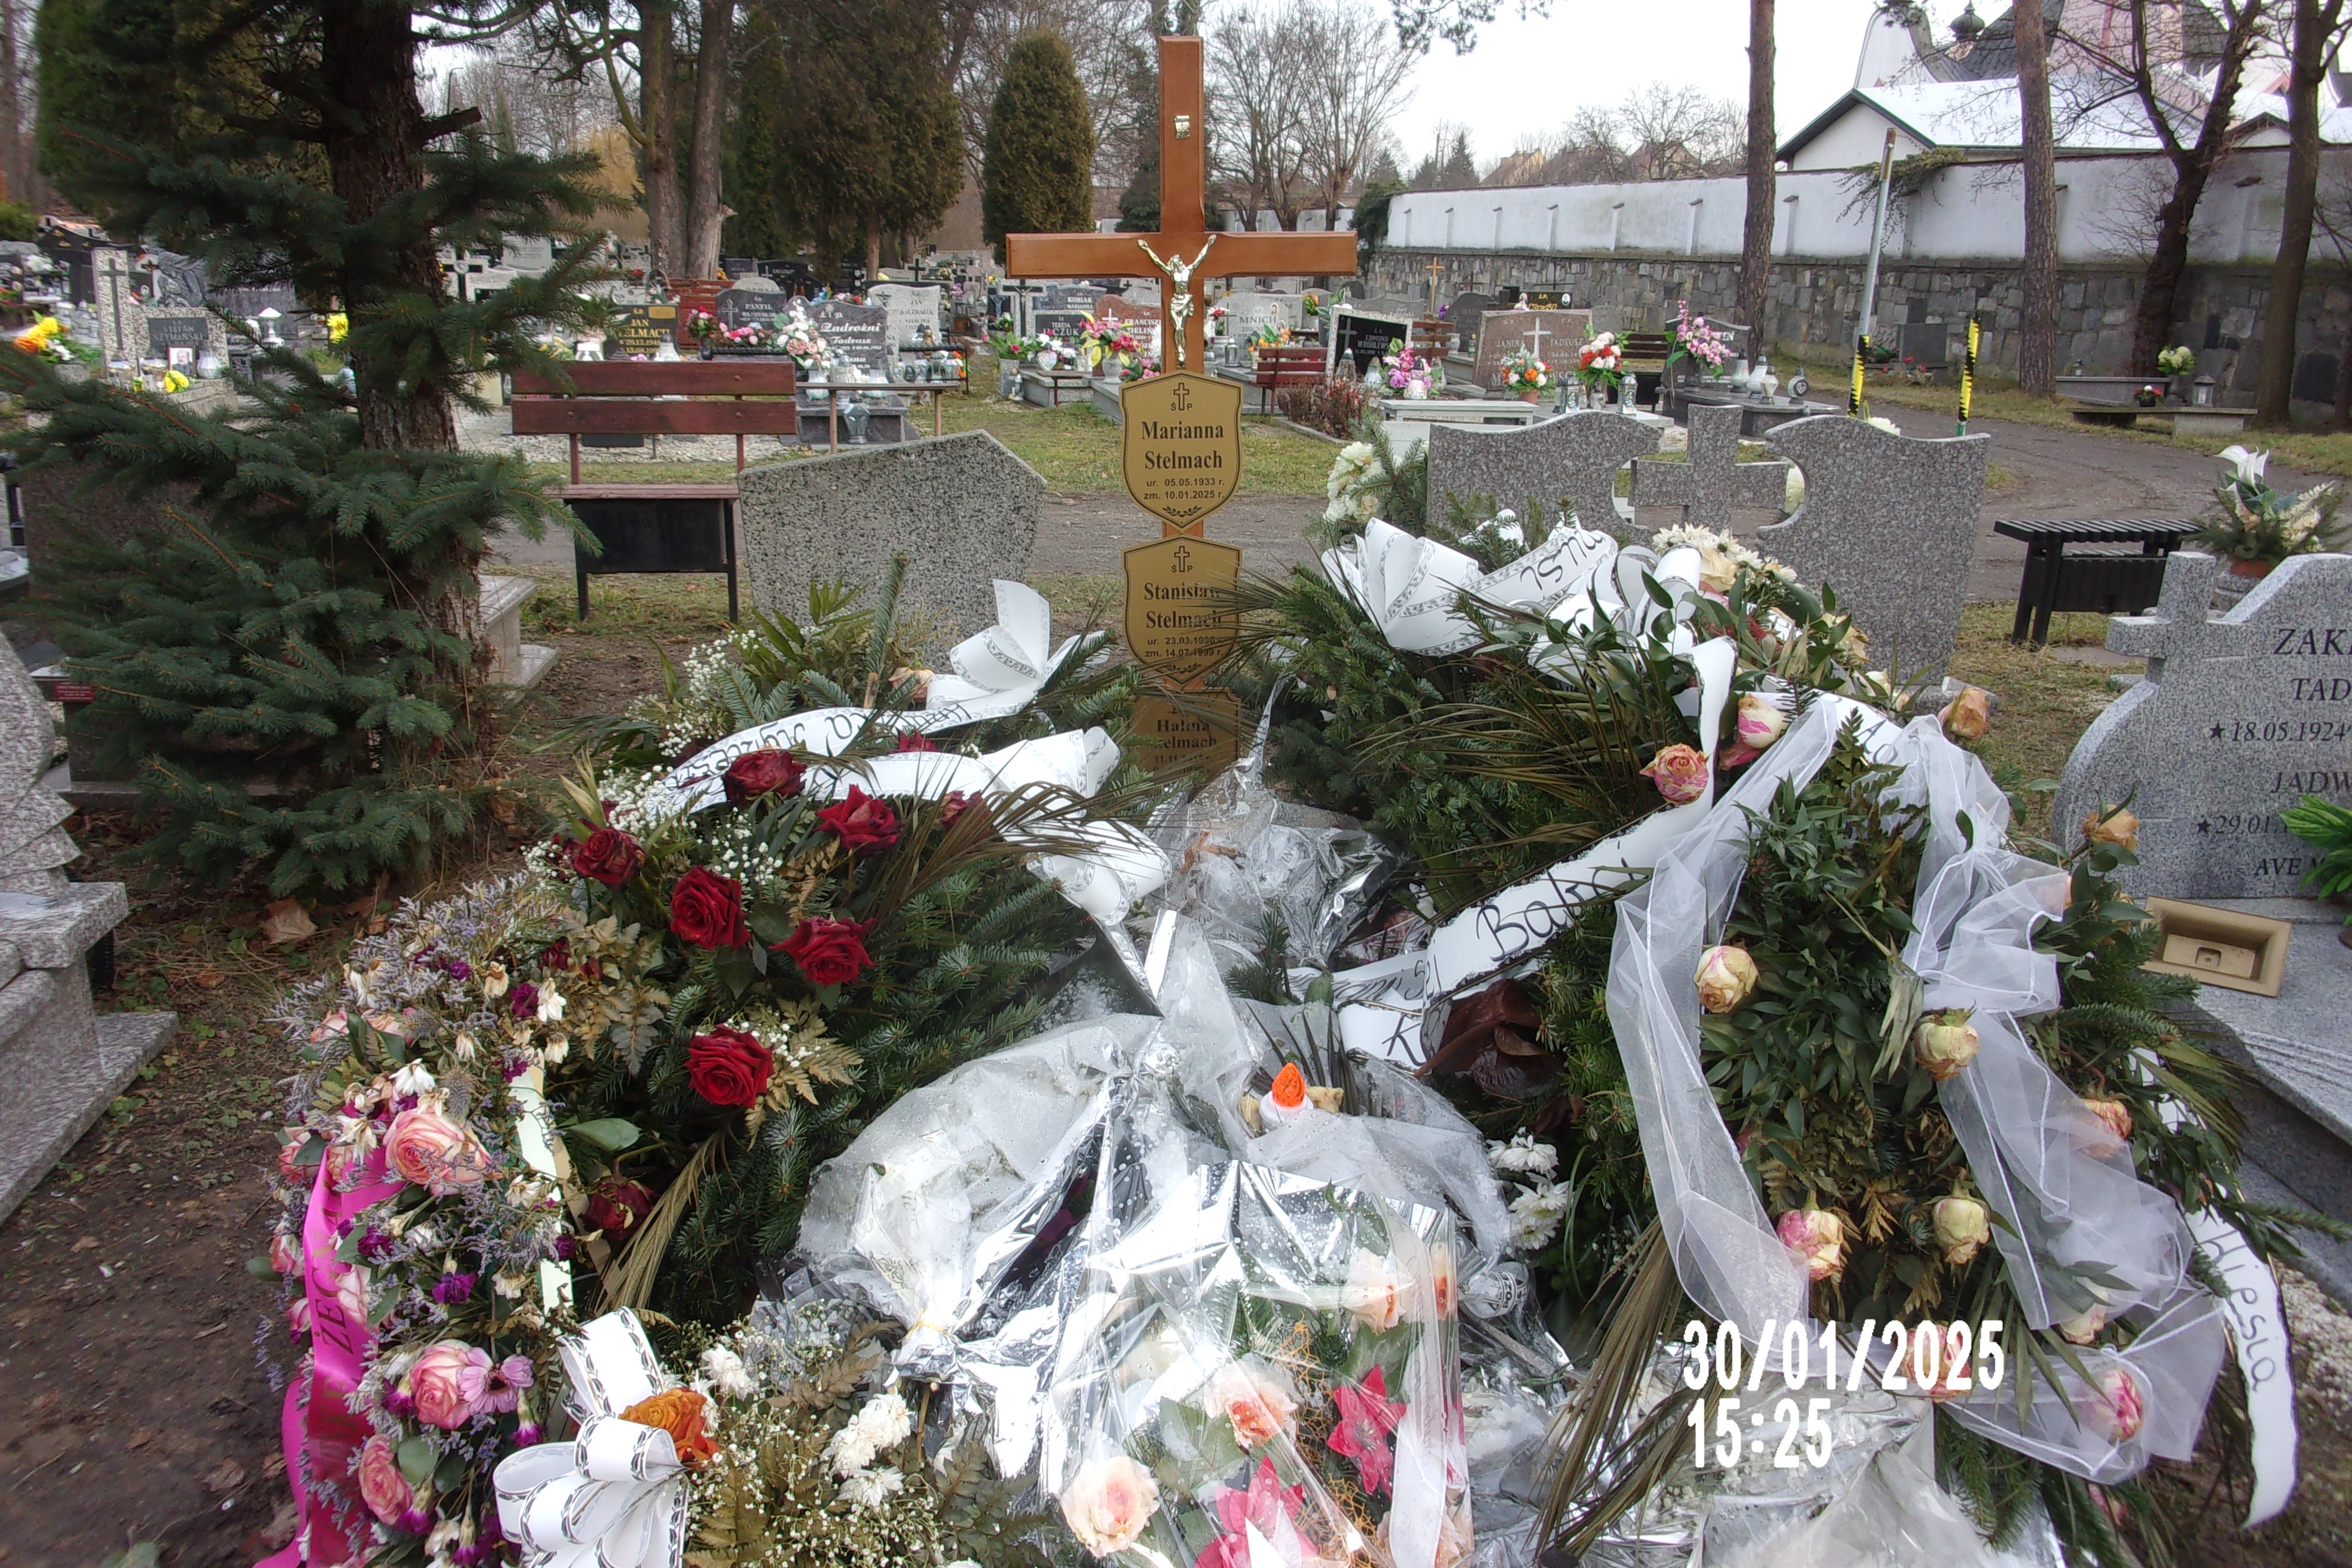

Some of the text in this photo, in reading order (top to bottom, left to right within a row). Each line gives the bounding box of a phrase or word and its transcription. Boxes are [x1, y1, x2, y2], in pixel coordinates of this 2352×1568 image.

[630, 318, 649, 327] JAN
[618, 328, 670, 337] ELMACH
[1358, 340, 1389, 350] WRÓBLEWS
[1551, 338, 1583, 347] TADEUSZ
[1141, 421, 1224, 440] Marianna
[1145, 450, 1222, 470] Stelmach
[1164, 478, 1216, 487] 05.05.1933
[1144, 492, 1161, 500] zm.
[1165, 491, 1215, 500] 10.01.2025
[1146, 610, 1222, 629] Stelmach
[2290, 678, 2351, 701] TAD
[2232, 722, 2346, 741] 18.05.1924
[1154, 736, 1217, 749] elmach
[2253, 857, 2302, 876] AVE
